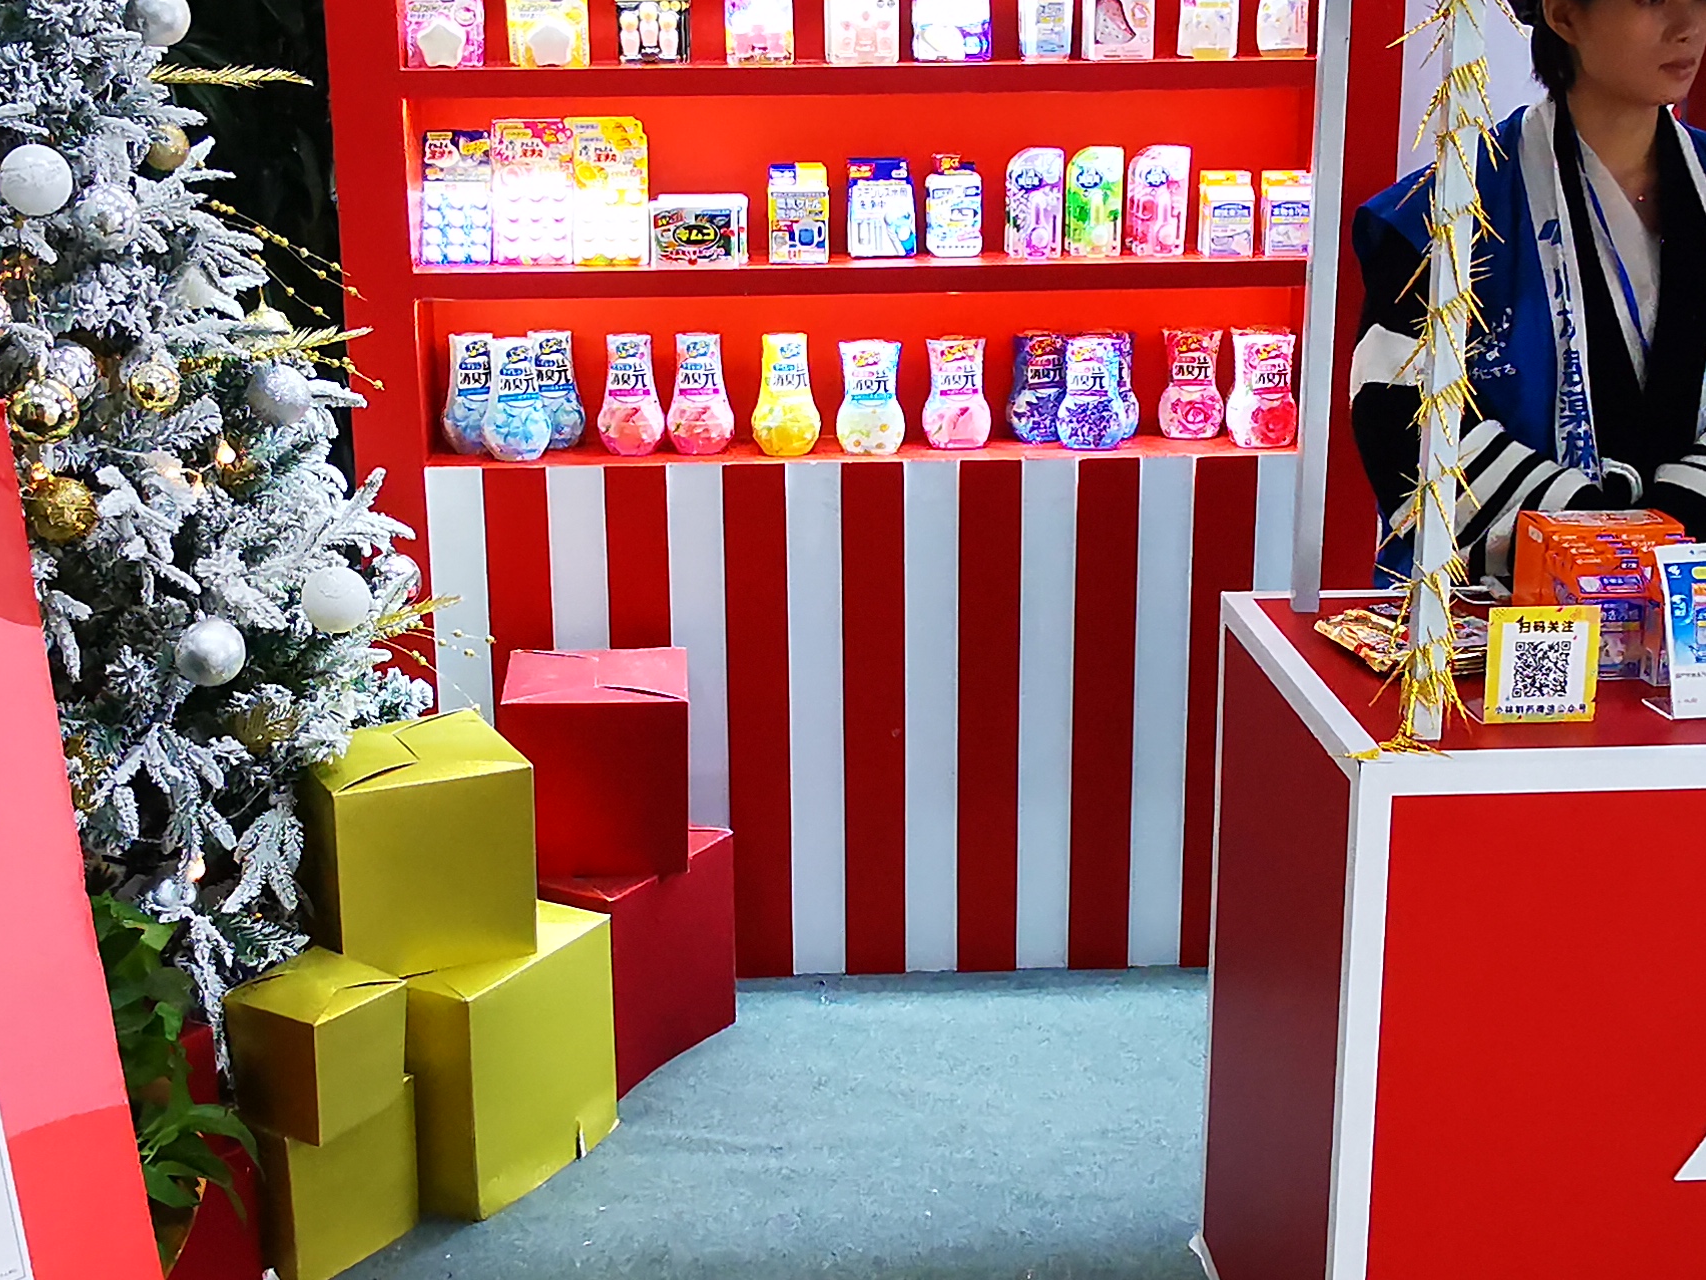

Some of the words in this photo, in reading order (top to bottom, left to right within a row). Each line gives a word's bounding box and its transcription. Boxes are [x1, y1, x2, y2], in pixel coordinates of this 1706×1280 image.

[676, 228, 716, 242] キムコ
[1518, 620, 1575, 634] 扫码关注
